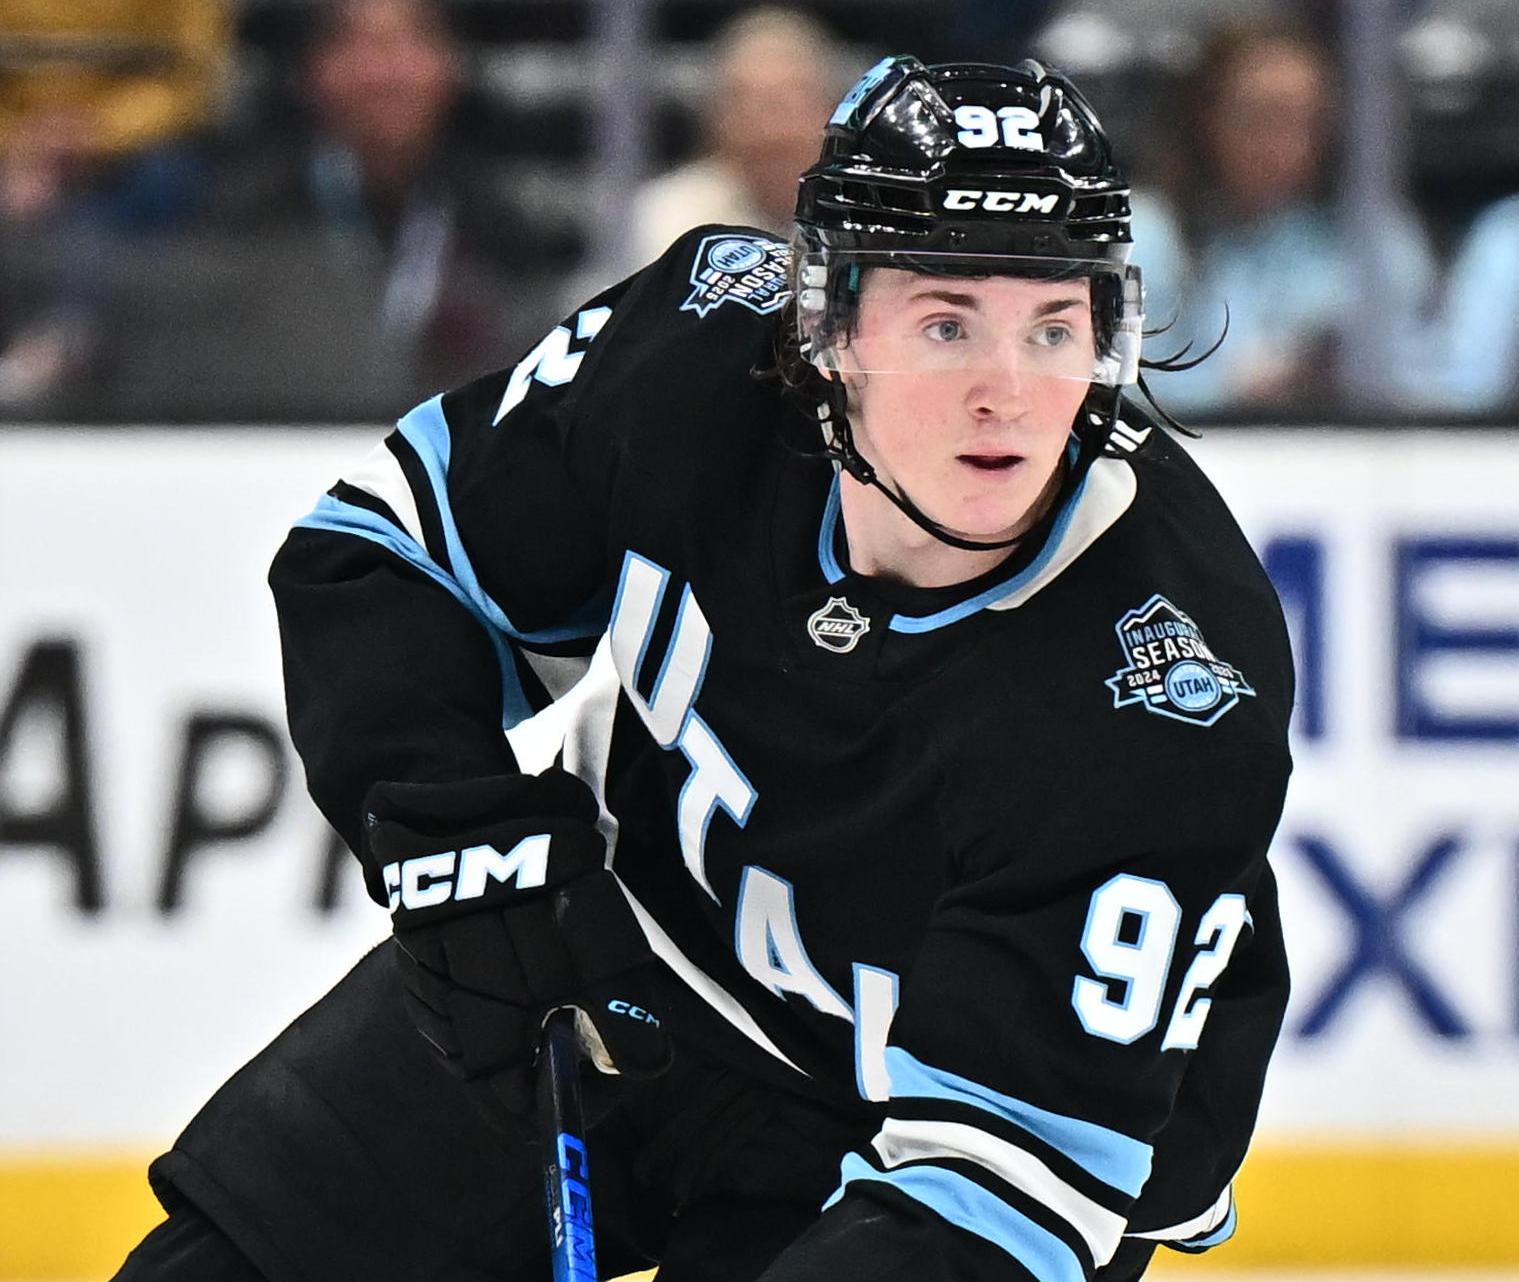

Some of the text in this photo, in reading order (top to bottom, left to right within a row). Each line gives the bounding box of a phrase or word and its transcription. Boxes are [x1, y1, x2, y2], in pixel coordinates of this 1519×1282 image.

[953, 105, 1045, 152] 92
[943, 190, 1059, 214] CCM
[817, 621, 855, 634] NHL
[1126, 669, 1162, 687] 2024
[1172, 676, 1215, 699] UTAH
[1072, 873, 1254, 1052] 92
[607, 1000, 660, 1029] CCM
